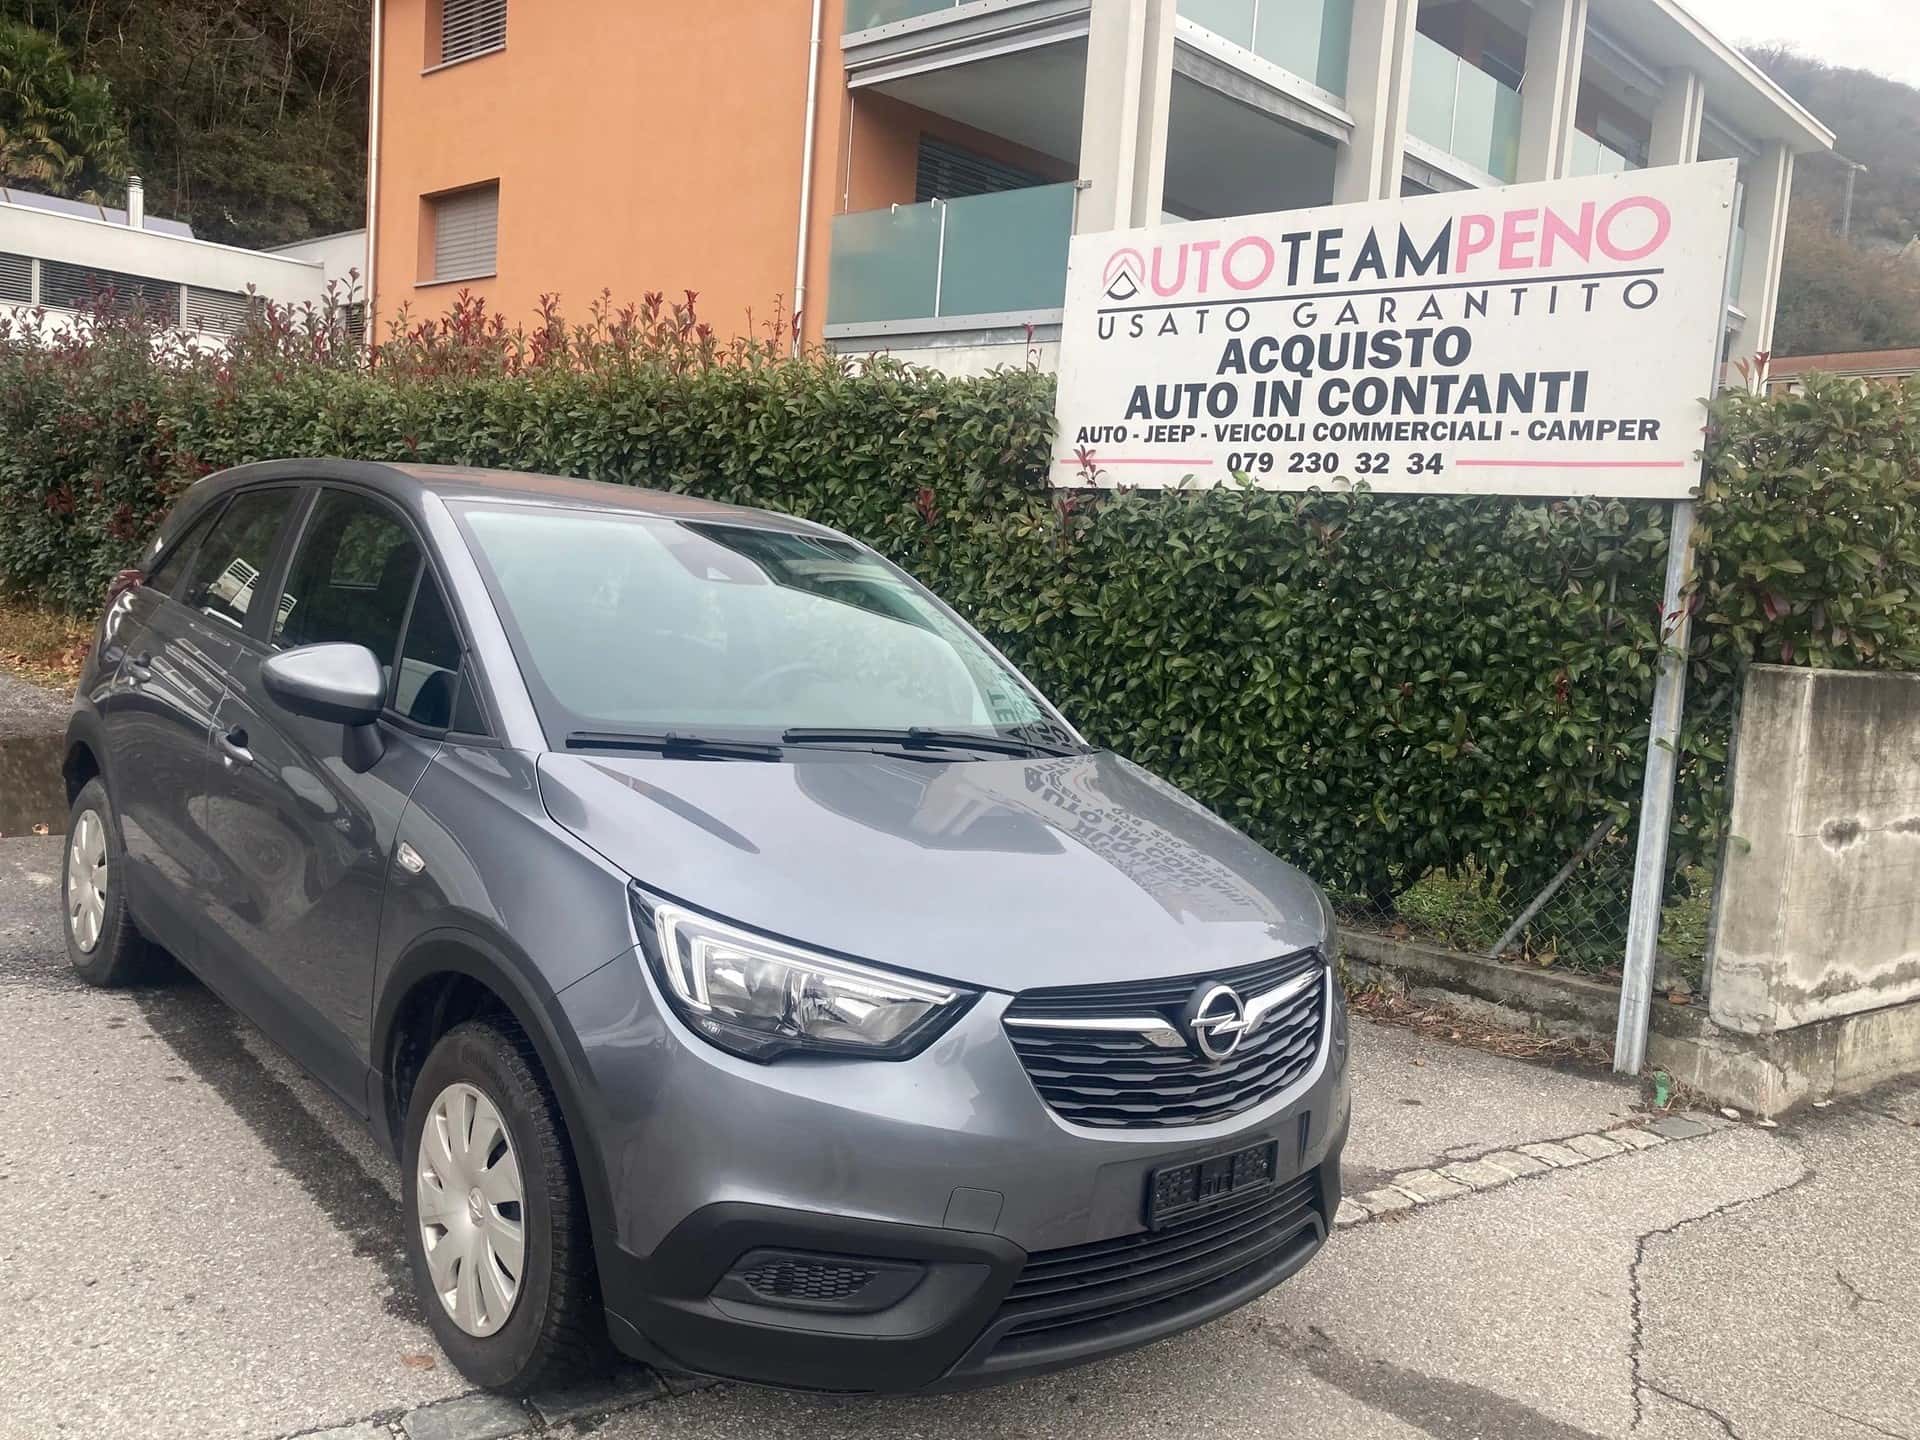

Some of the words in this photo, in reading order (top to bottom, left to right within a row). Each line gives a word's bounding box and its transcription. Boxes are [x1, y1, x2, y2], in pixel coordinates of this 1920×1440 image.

[1098, 306, 1251, 340] USATO
[1292, 278, 1659, 329] GARANTITO
[1216, 326, 1473, 378] ACQUISTO
[1124, 382, 1239, 420] AUTO
[1252, 379, 1303, 418] IN
[1317, 370, 1590, 417] CONTANTI
[1076, 425, 1128, 444] AUTO
[1143, 424, 1196, 443] JEEP
[1214, 422, 1306, 443] VEICOLI
[1312, 420, 1503, 442] COMMERCIALI
[1527, 419, 1662, 442] CAMPER
[1226, 452, 1275, 474] 079
[1288, 452, 1340, 474] 230
[1354, 452, 1391, 475] 32
[1406, 452, 1445, 476] 34
